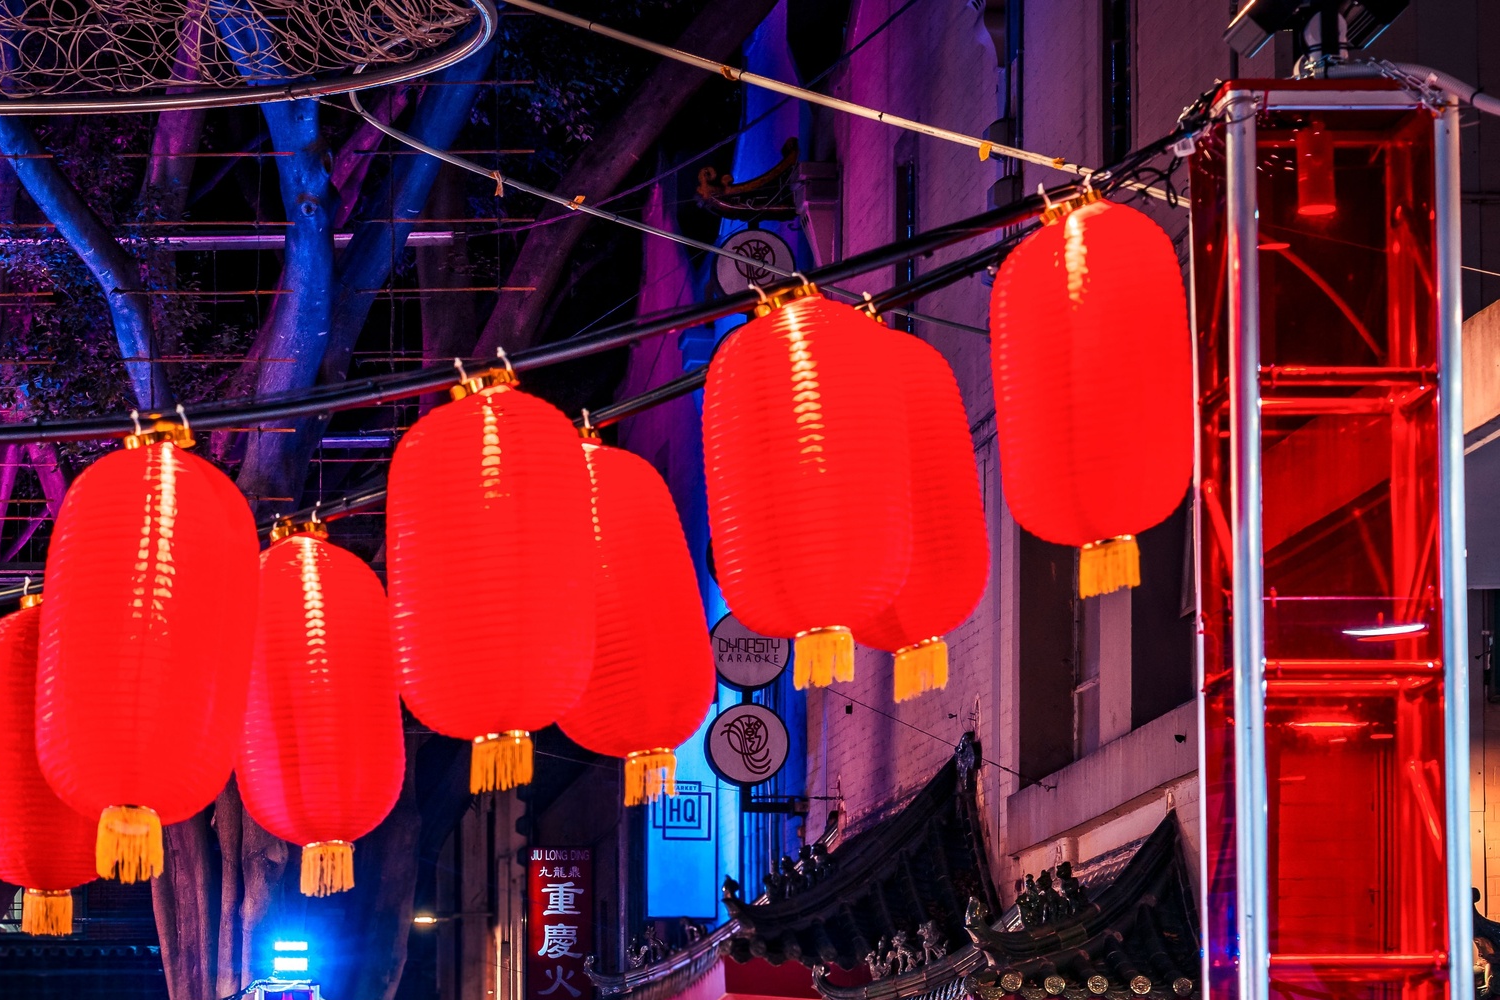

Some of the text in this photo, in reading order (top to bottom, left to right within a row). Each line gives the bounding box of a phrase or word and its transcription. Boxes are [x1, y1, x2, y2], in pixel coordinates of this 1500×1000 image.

[718, 638, 781, 653] DYNASTY
[718, 654, 779, 663] KARAOKE
[669, 798, 696, 822] HQ
[530, 849, 590, 861] JIU LONG DING
[538, 865, 581, 878] 九龍鼎
